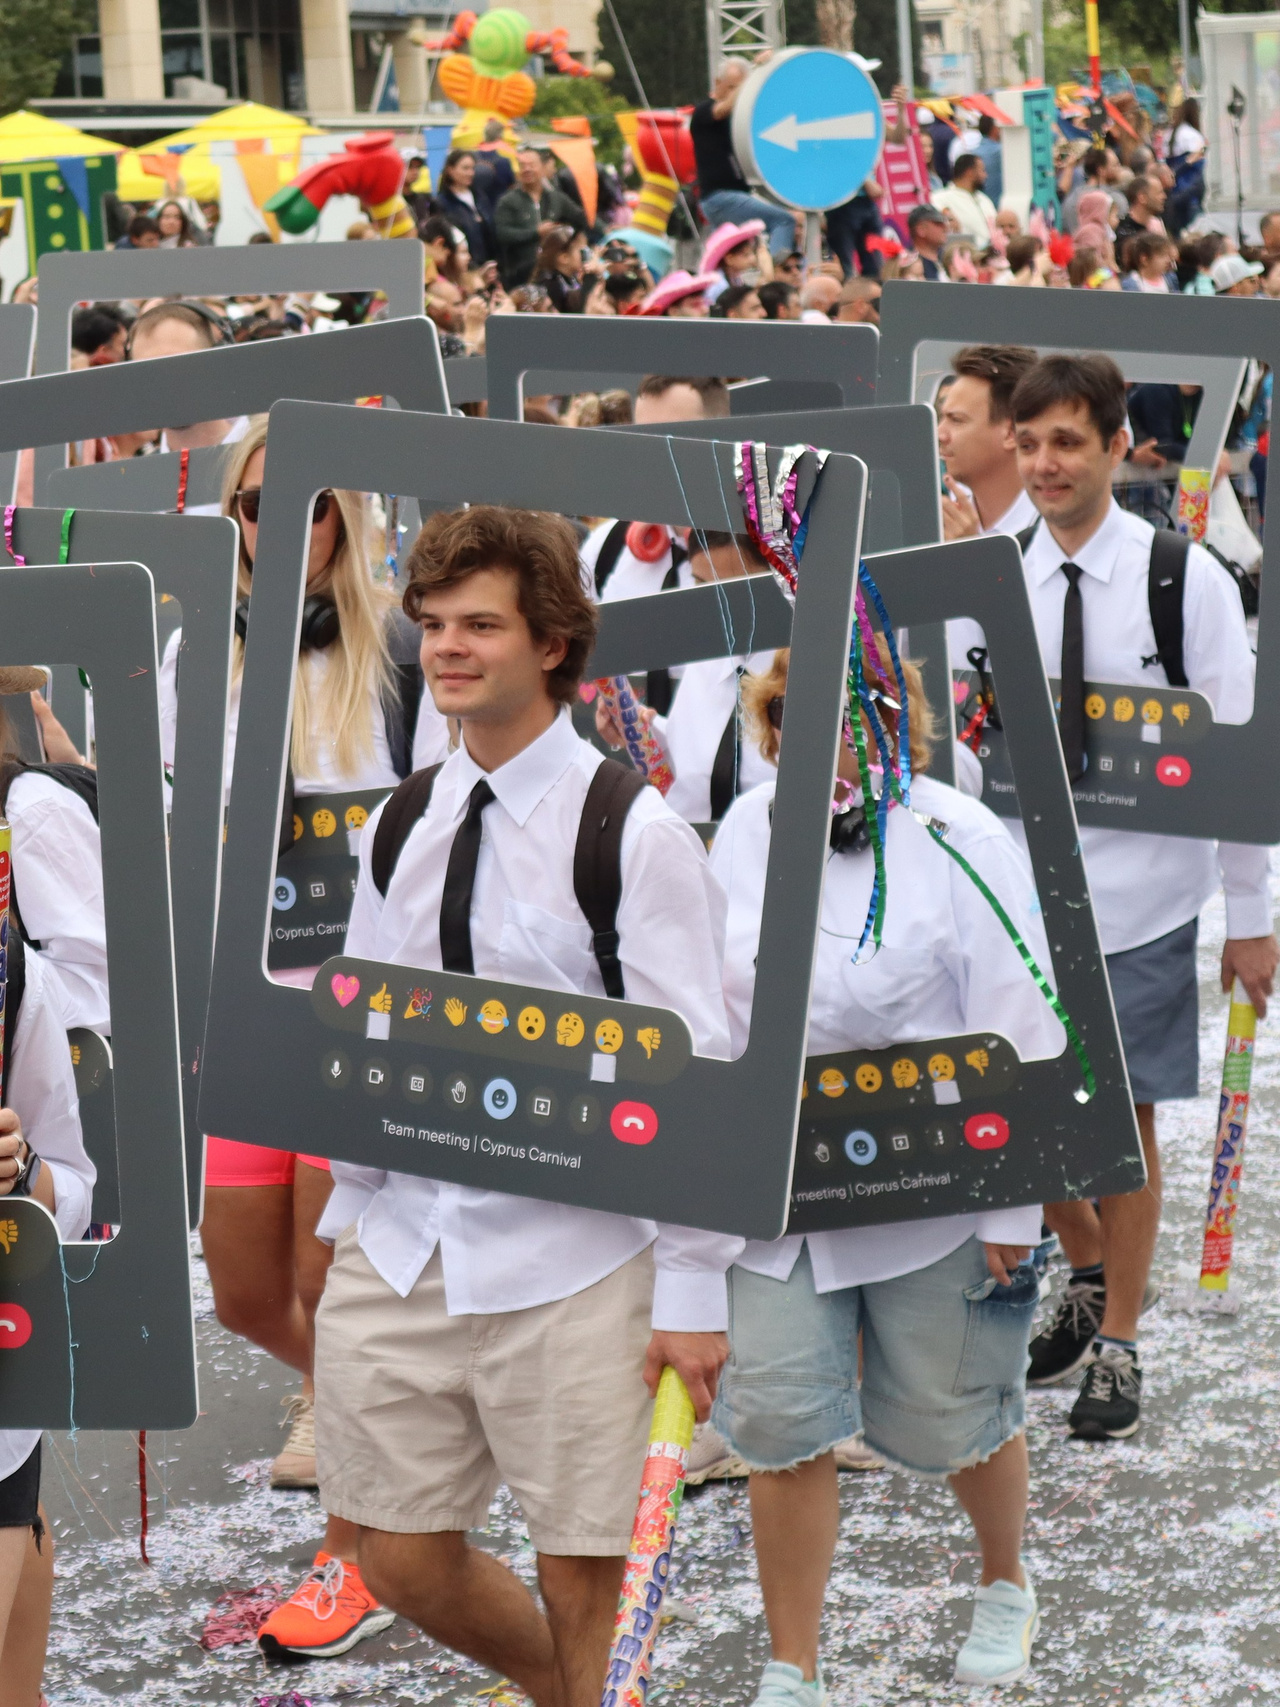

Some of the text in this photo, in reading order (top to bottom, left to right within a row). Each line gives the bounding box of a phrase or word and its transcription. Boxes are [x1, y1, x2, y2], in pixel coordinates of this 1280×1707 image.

[990, 780, 1016, 794] Team
[1073, 792, 1137, 807] yprus Carnival
[276, 927, 315, 941] Cyprus
[317, 921, 349, 936] Carni
[381, 1119, 415, 1138] Team
[418, 1129, 470, 1151] meeting
[480, 1138, 526, 1159] Cyprus
[528, 1147, 581, 1169] Carnival
[796, 1186, 847, 1202] meeting
[855, 1180, 899, 1197] Cyprus
[901, 1172, 951, 1190] Carnival
[599, 1525, 676, 1707] OPPER
